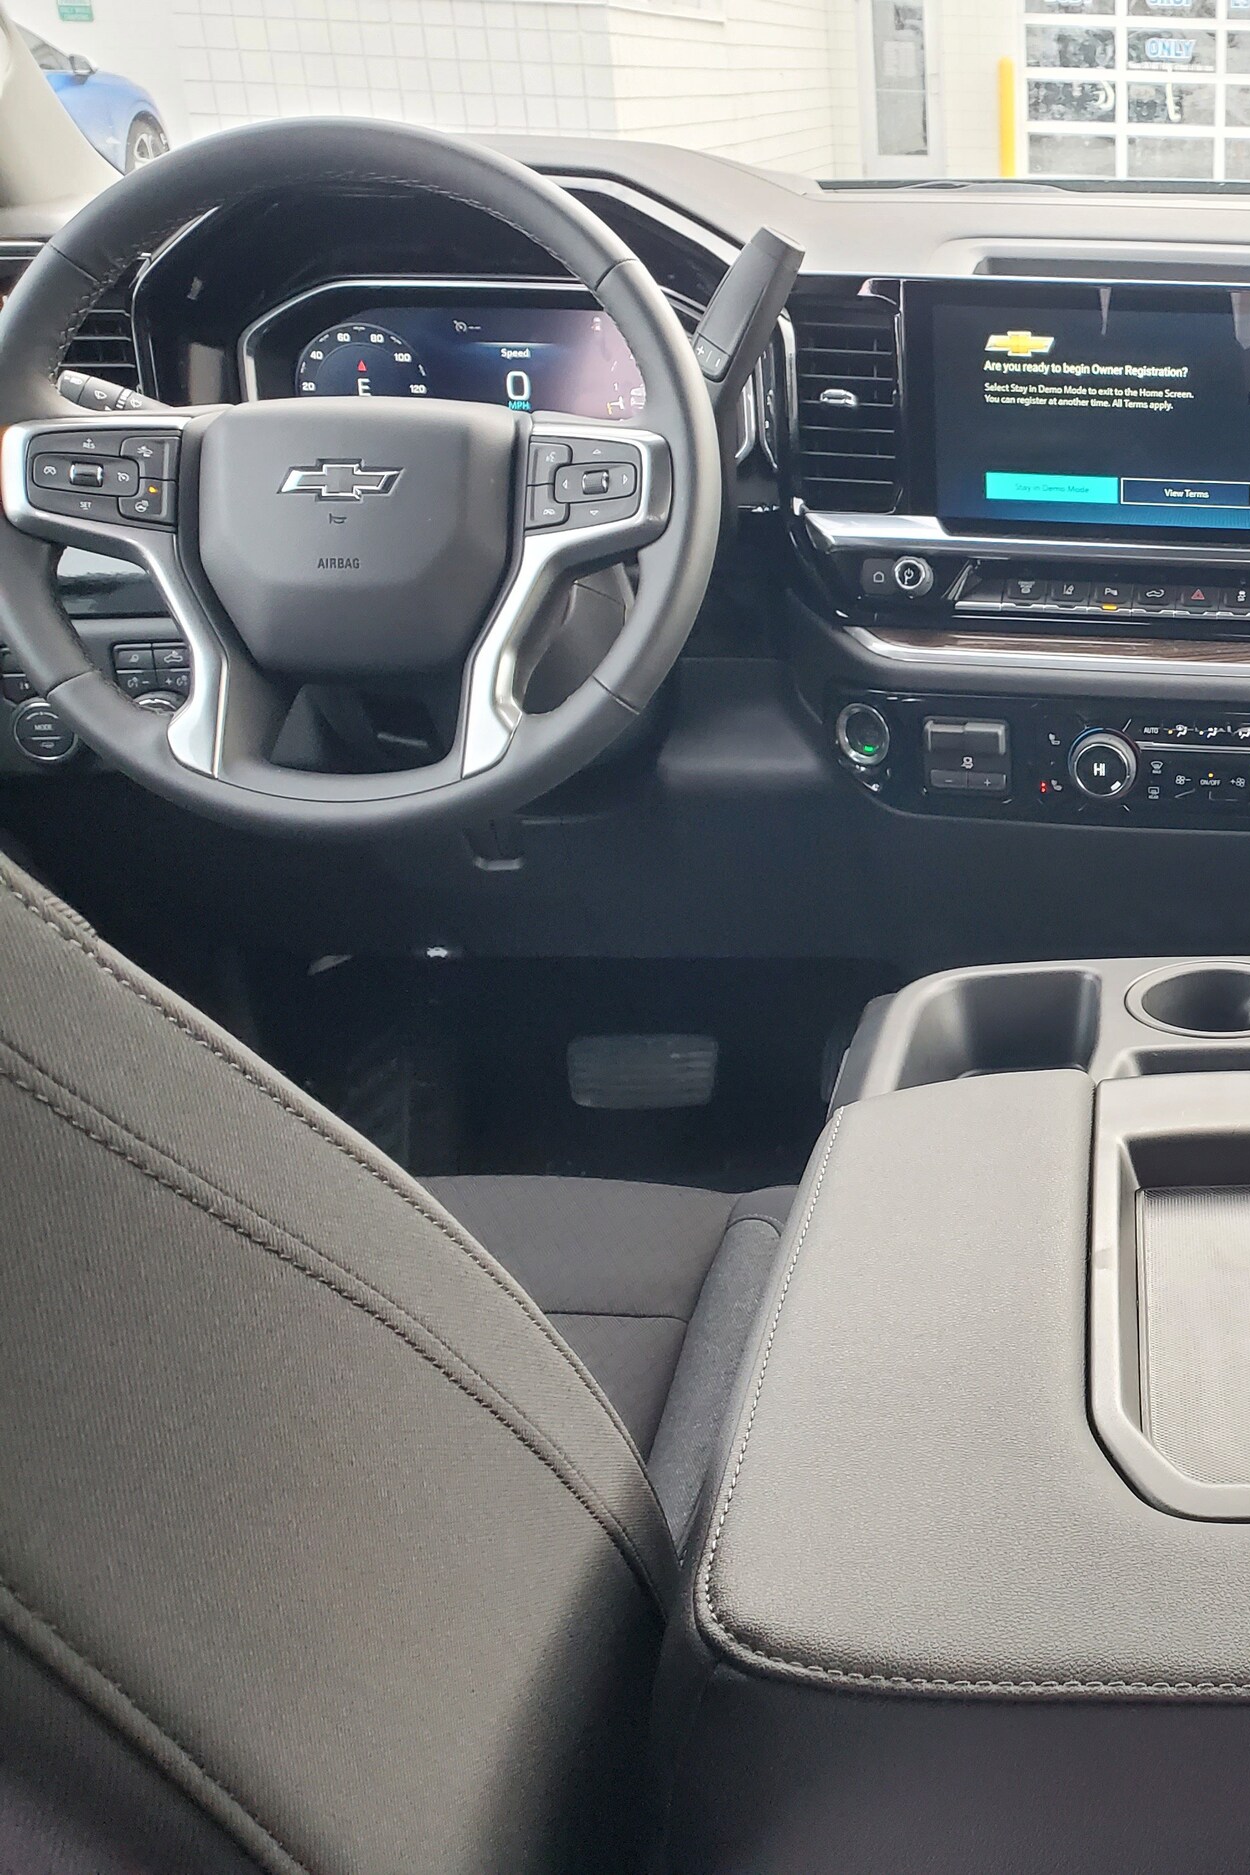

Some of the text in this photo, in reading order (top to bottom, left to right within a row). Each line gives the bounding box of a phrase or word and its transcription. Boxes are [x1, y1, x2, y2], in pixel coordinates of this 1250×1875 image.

[1148, 39, 1193, 57] ONLY
[336, 332, 384, 343] 60 80
[310, 350, 412, 362] 40 100
[501, 348, 531, 359] Speed
[984, 360, 1188, 378] Are you ready to begin Owner Registration?
[302, 378, 427, 396] 20 E 120
[506, 370, 530, 401] 0
[984, 382, 1194, 399] Select Stay in Demo Mode to exit to the Home Screen.
[508, 400, 530, 411] MPH
[984, 394, 1000, 404] You
[1017, 396, 1048, 406] register
[1058, 398, 1090, 407] another
[1090, 399, 1111, 408] time.
[1112, 400, 1122, 408] All
[1124, 400, 1148, 409] Terms
[1150, 400, 1174, 412] apply.
[1015, 483, 1032, 492] Stay
[1042, 484, 1066, 493] Demo
[1164, 488, 1210, 499] View Terms
[318, 558, 360, 569] AIRBAG
[34, 724, 52, 732] MODE
[1144, 726, 1159, 734] AUTO
[1093, 762, 1106, 776] HI
